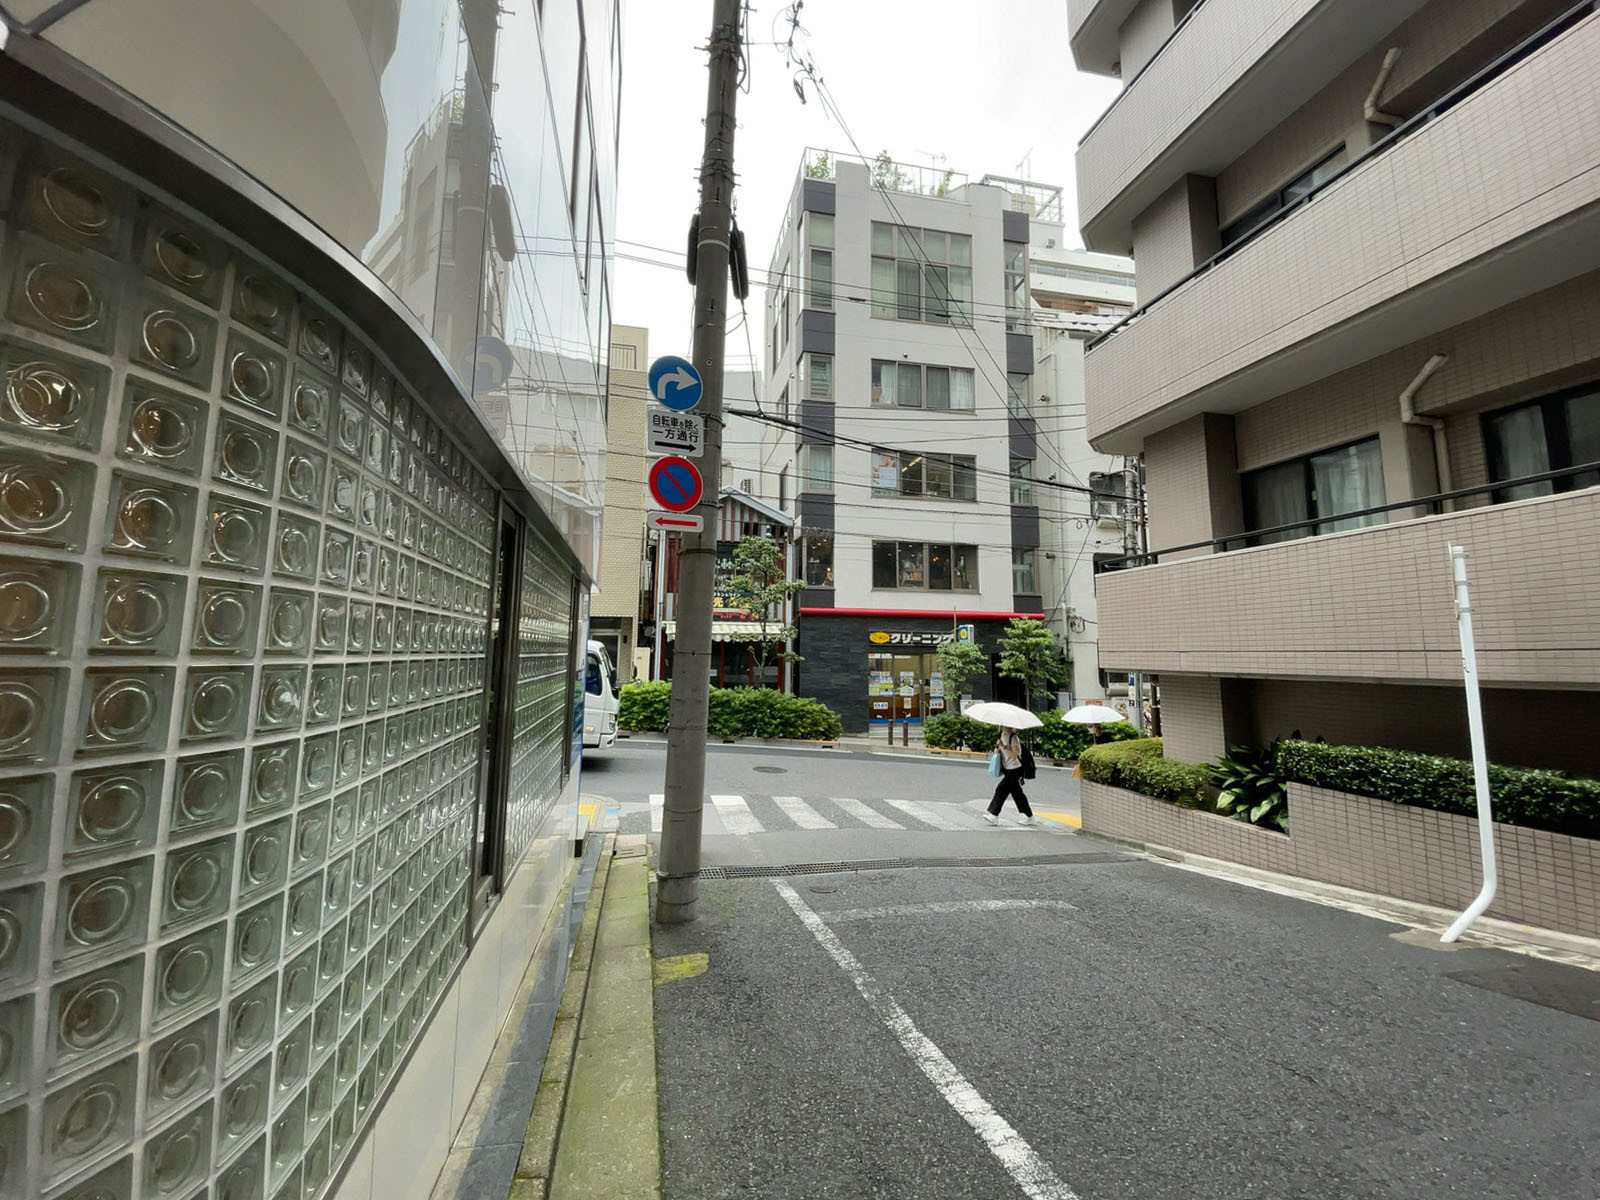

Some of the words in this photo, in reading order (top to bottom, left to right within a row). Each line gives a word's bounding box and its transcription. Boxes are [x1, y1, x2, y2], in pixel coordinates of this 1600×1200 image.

[652, 414, 699, 431] 自転車を除く
[652, 429, 699, 443] 一方通行
